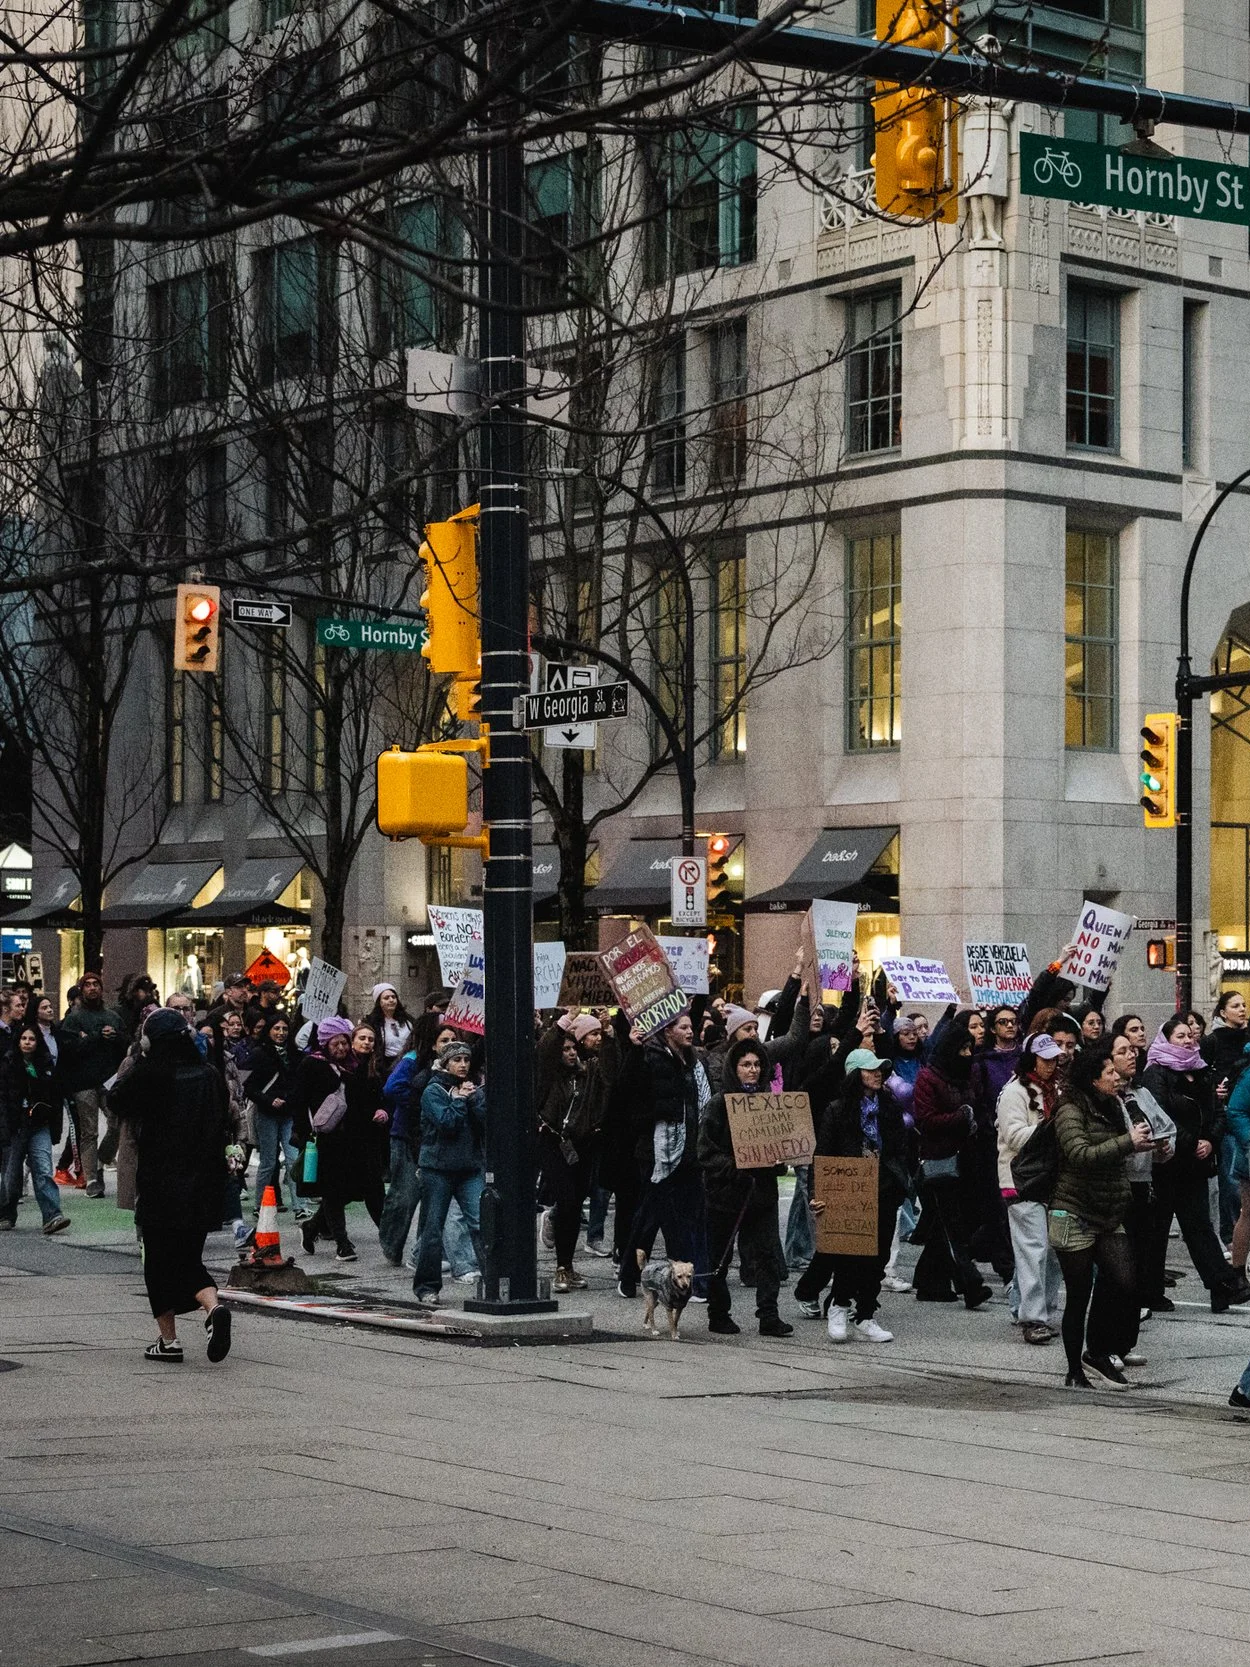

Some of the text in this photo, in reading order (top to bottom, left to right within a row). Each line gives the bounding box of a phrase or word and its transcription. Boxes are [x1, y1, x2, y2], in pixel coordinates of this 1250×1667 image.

[1105, 153, 1245, 214] Hornby St
[240, 607, 273, 618] ONE WAY
[361, 625, 417, 650] Hornby
[529, 689, 604, 722] W Georgia St
[822, 850, 859, 862] ba&sh
[456, 923, 474, 935] NO
[1082, 908, 1123, 939] QUIEN
[1077, 931, 1101, 950] NO
[602, 945, 623, 970] POR
[626, 934, 643, 949] EL
[966, 944, 1029, 962] DESDE VENEZUELA
[1069, 948, 1092, 965] NO
[321, 962, 338, 978] MORE
[615, 960, 647, 985] QUE NOS
[697, 961, 706, 970] TU
[968, 959, 995, 976] HASTA
[1066, 961, 1087, 978] NO
[995, 976, 1034, 992] GUERRAS
[975, 989, 1026, 1005] IMPERIALIST
[634, 988, 688, 1033] ABORTADO
[731, 1093, 807, 1115] MEXICO
[752, 1110, 794, 1127] DEJAME
[739, 1121, 796, 1141] CAMINAR
[737, 1136, 811, 1165] SIN MIEDO
[822, 1165, 859, 1177] SOMOS
